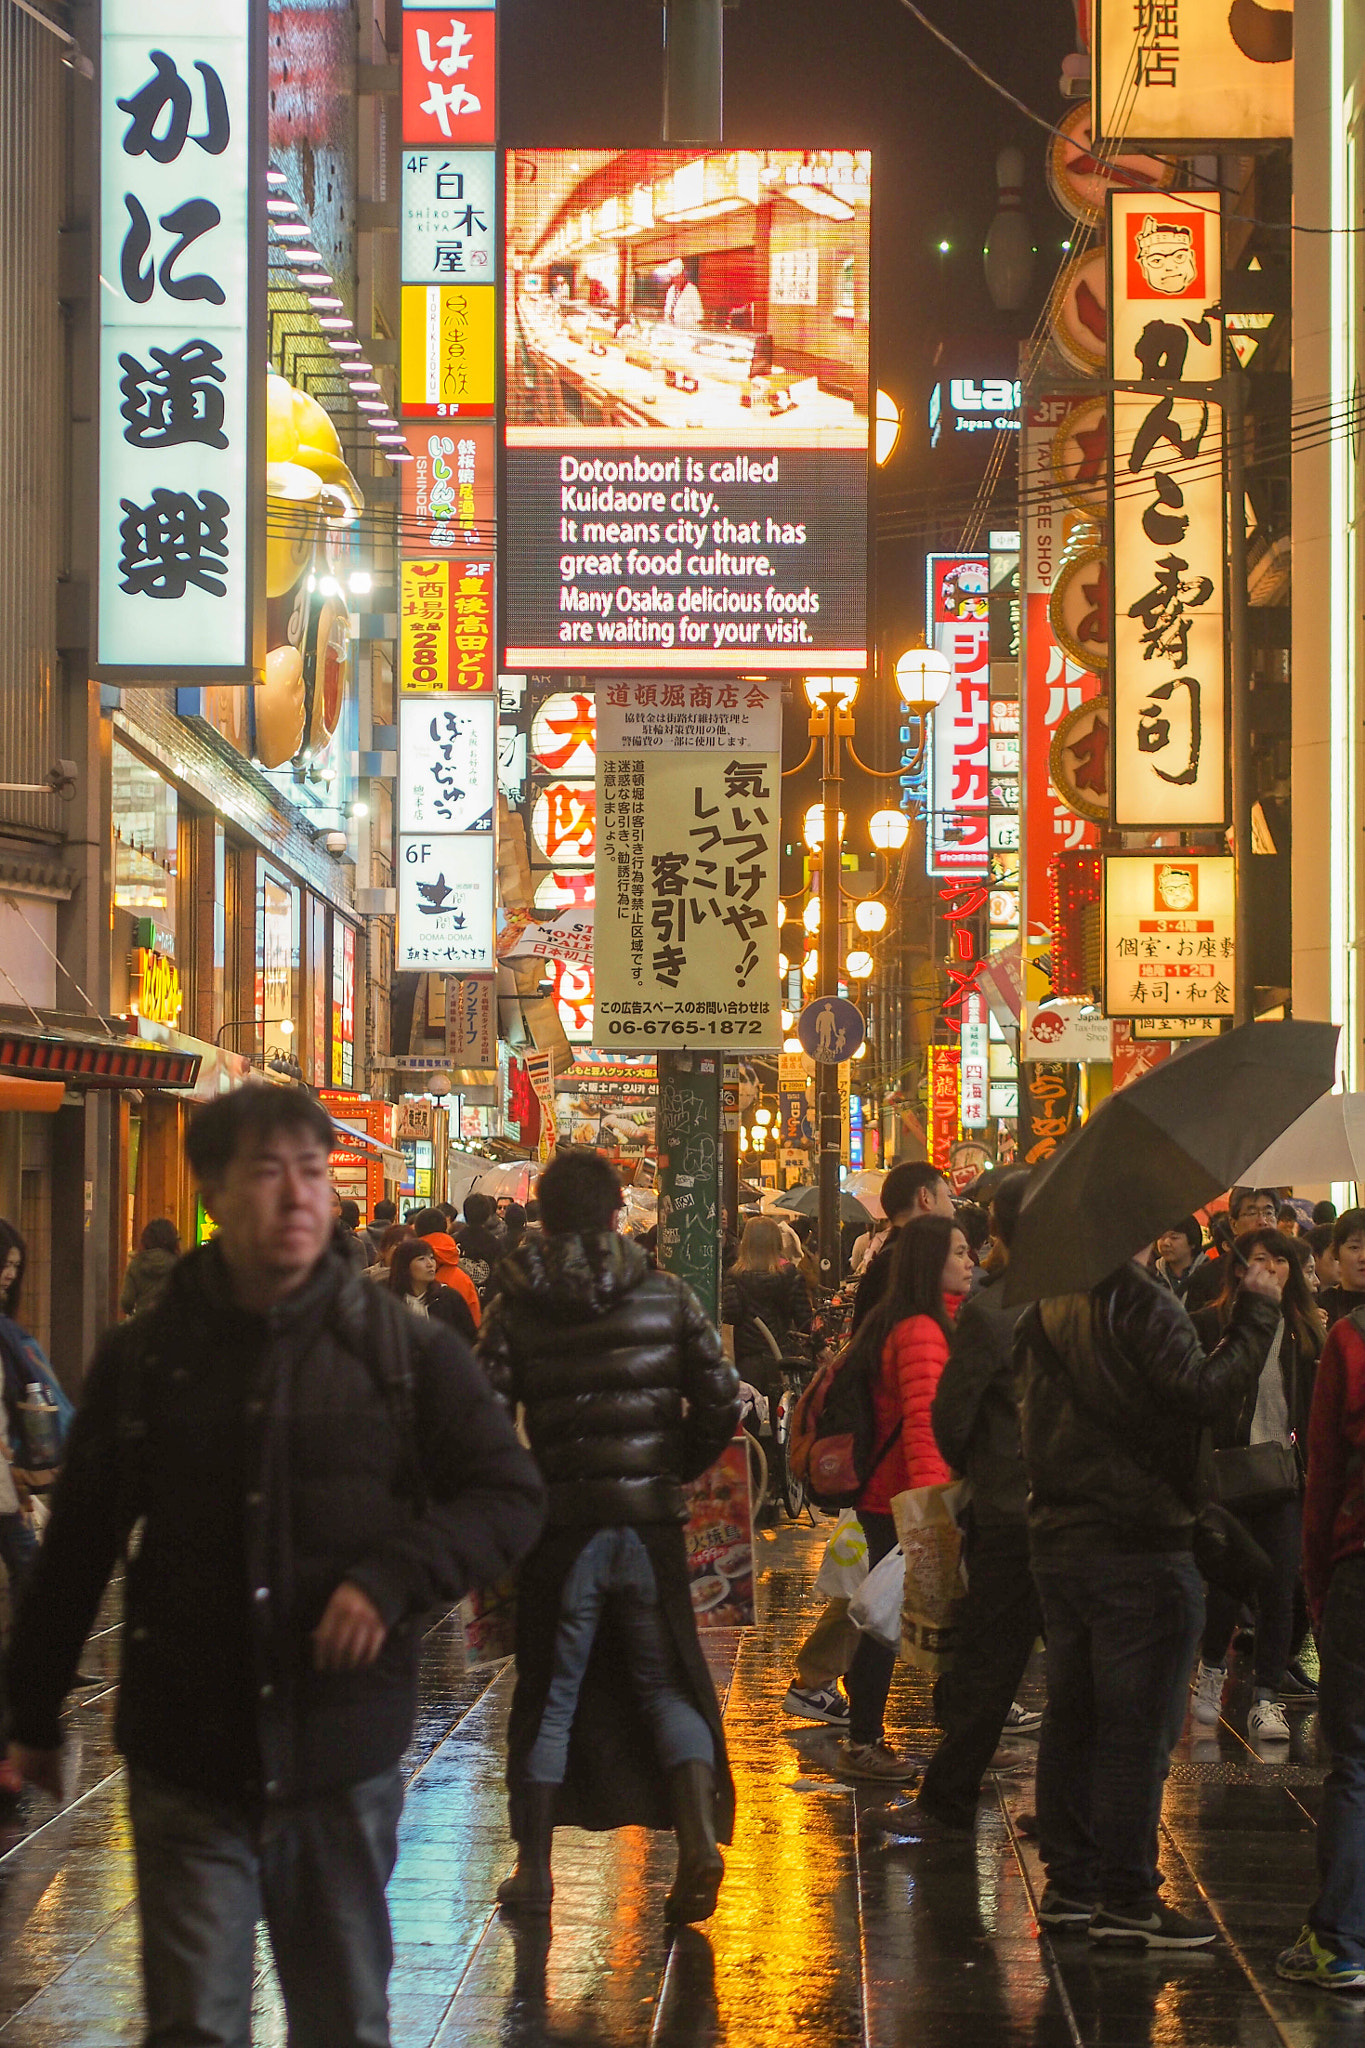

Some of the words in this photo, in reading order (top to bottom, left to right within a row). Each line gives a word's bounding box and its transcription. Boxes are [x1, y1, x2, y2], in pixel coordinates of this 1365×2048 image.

[415, 18, 481, 138] はや
[406, 155, 429, 173] 4F
[431, 161, 488, 272] 白木屋
[436, 403, 459, 416] 3F
[955, 416, 993, 432] Japan
[560, 454, 680, 482] Dotonbori
[686, 456, 704, 482] is
[709, 455, 779, 482] called
[416, 455, 428, 527] ISHINDEN
[561, 485, 666, 512] Kuidaore
[670, 486, 720, 518] city.
[561, 517, 578, 543] It
[583, 522, 660, 543] means
[665, 518, 708, 549] city
[713, 517, 761, 543] that
[766, 517, 806, 543] has
[465, 563, 491, 576] 2F
[559, 552, 623, 580] great
[627, 548, 682, 576] food
[687, 549, 776, 576] culture.
[1037, 535, 1052, 588] SHOP
[403, 580, 448, 620] 酒場
[560, 585, 613, 617] Many
[616, 585, 674, 612] Osaka
[677, 585, 762, 613] delicious
[765, 585, 819, 613] foods
[410, 622, 441, 631] 全品
[454, 577, 489, 690] 豊後高田どり
[559, 621, 593, 641] are
[597, 617, 674, 648] waiting
[679, 615, 710, 642] for
[713, 622, 761, 648] your
[765, 618, 814, 643] visit.
[412, 632, 438, 683] 280
[605, 683, 770, 709] 道頓堀商店会
[624, 712, 750, 723] 協賛金は街路灯維持管理と
[641, 724, 731, 735] 駐輪対策費用の他、
[621, 735, 751, 747] 警備費の一部に使用します。
[951, 630, 988, 846] ジャンカラ
[475, 819, 491, 830] 2F
[603, 760, 617, 863] 注意しましょう。
[405, 844, 432, 863] 6F
[617, 760, 631, 919] 迷惑な客引き、勧誘行為に
[631, 760, 645, 987] 道頓堀は客引き行為等禁止区域です。
[651, 851, 690, 988] 客引き
[600, 1001, 770, 1014] この広告スペースのお問い合わせは
[1129, 980, 1231, 1003] 寿司・和食
[466, 981, 478, 1045] クンテープ
[608, 1020, 762, 1035] 06-6765-1872
[1074, 1025, 1108, 1033] Tax-free
[1086, 1034, 1108, 1044] Shop
